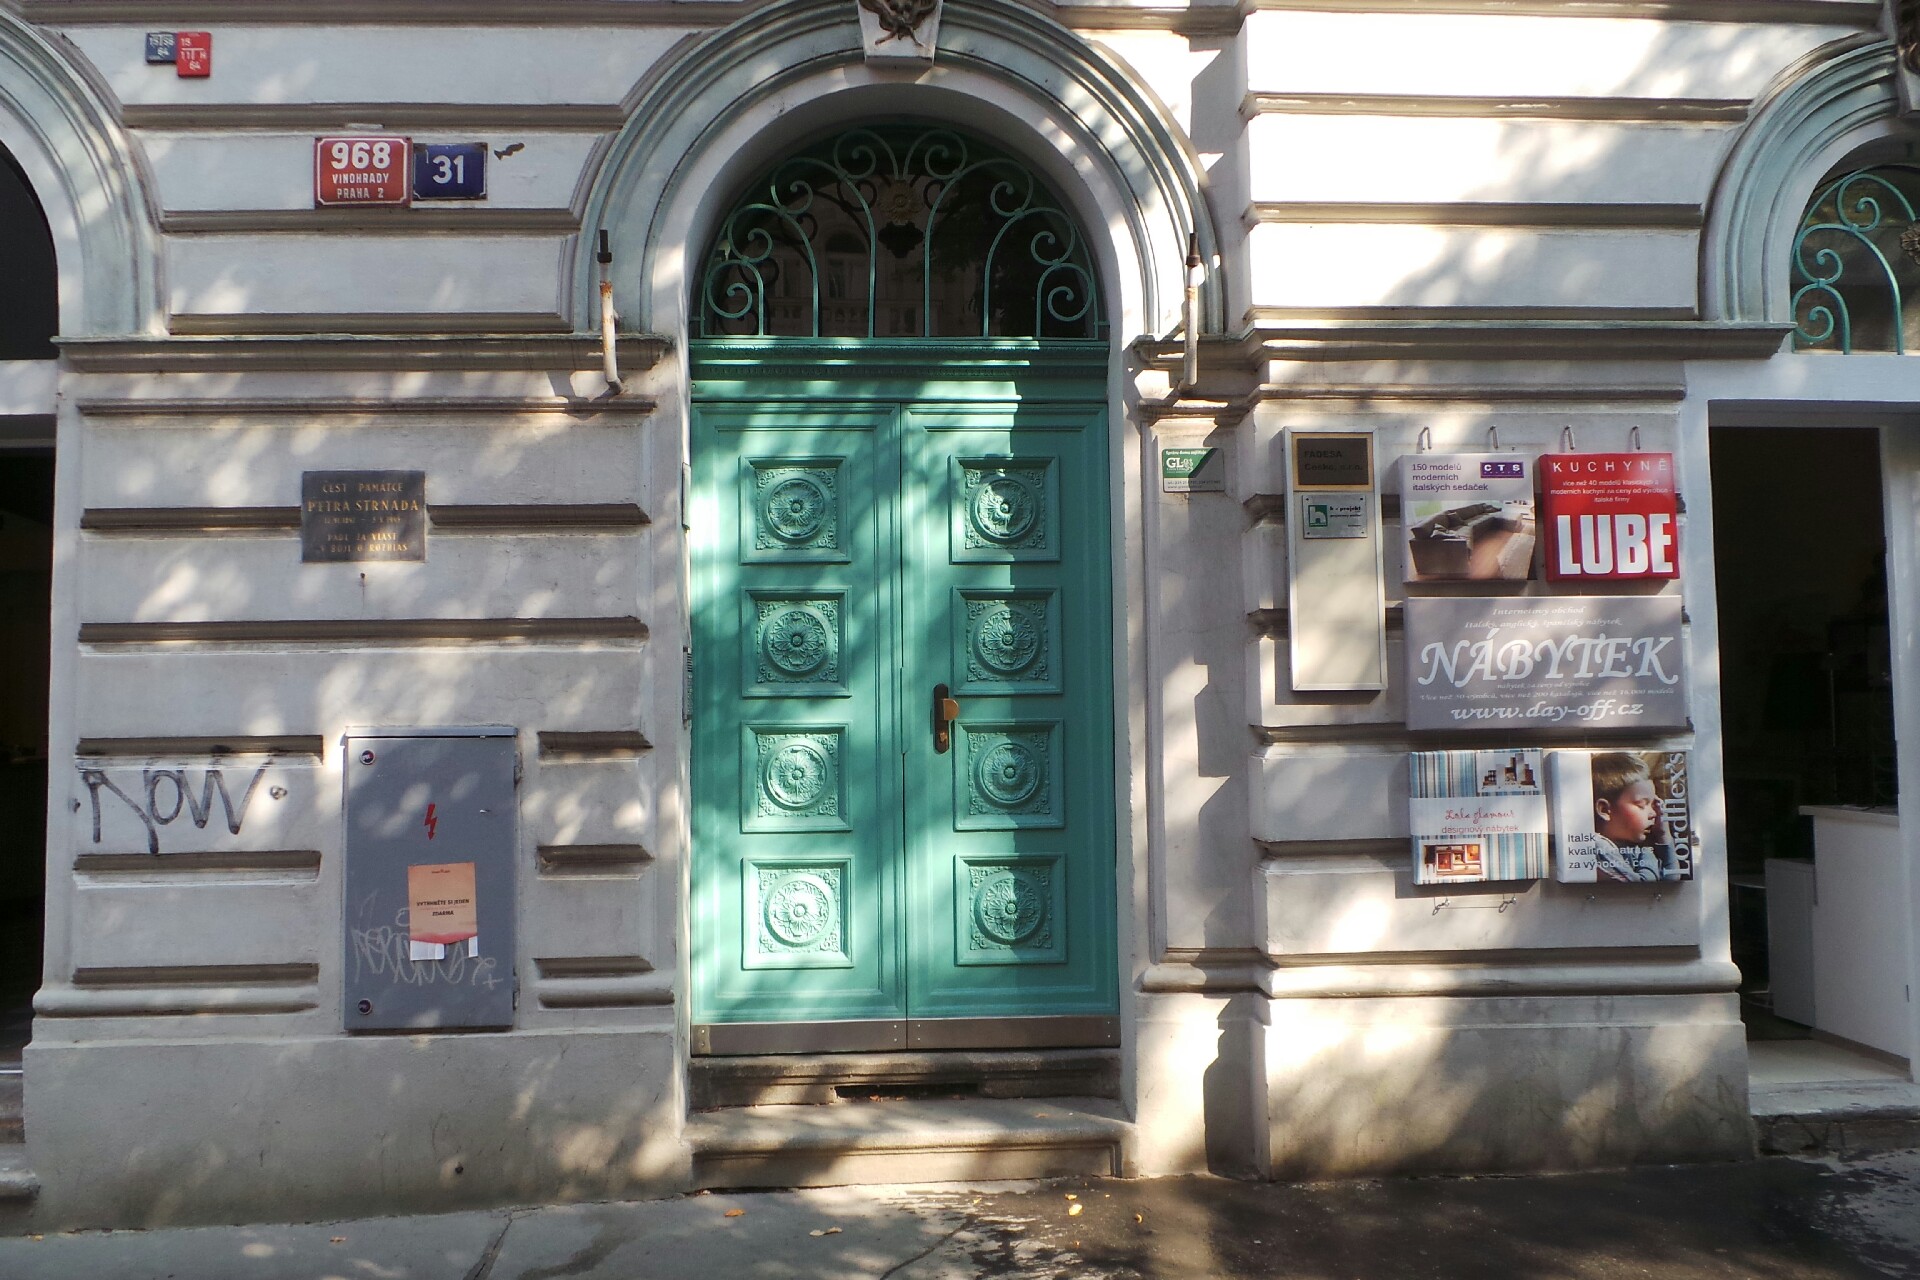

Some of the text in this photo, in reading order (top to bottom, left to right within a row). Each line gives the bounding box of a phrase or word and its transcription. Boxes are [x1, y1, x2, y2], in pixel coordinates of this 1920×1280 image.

[331, 142, 392, 170] 968
[432, 154, 465, 185] 31
[332, 173, 390, 184] VINOHRADY
[337, 187, 385, 199] PRAHA 2
[1304, 451, 1343, 459] FADESA
[1412, 463, 1462, 471] 150 modelů
[1412, 473, 1459, 481] moderních
[1412, 483, 1489, 492] italských sedaček
[1614, 496, 1631, 504] firmy
[307, 500, 420, 512] PETRA STRNADA
[371, 532, 398, 541] VLAST
[1556, 513, 1674, 576] LUBE
[1551, 605, 1587, 615] obchod
[1417, 628, 1679, 688] NÁBYTEK
[1451, 699, 1644, 721] www.day-off.cz
[1660, 752, 1691, 877] Lordflex's
[1485, 823, 1520, 834] nábytek
[1567, 833, 1601, 843] Italsk
